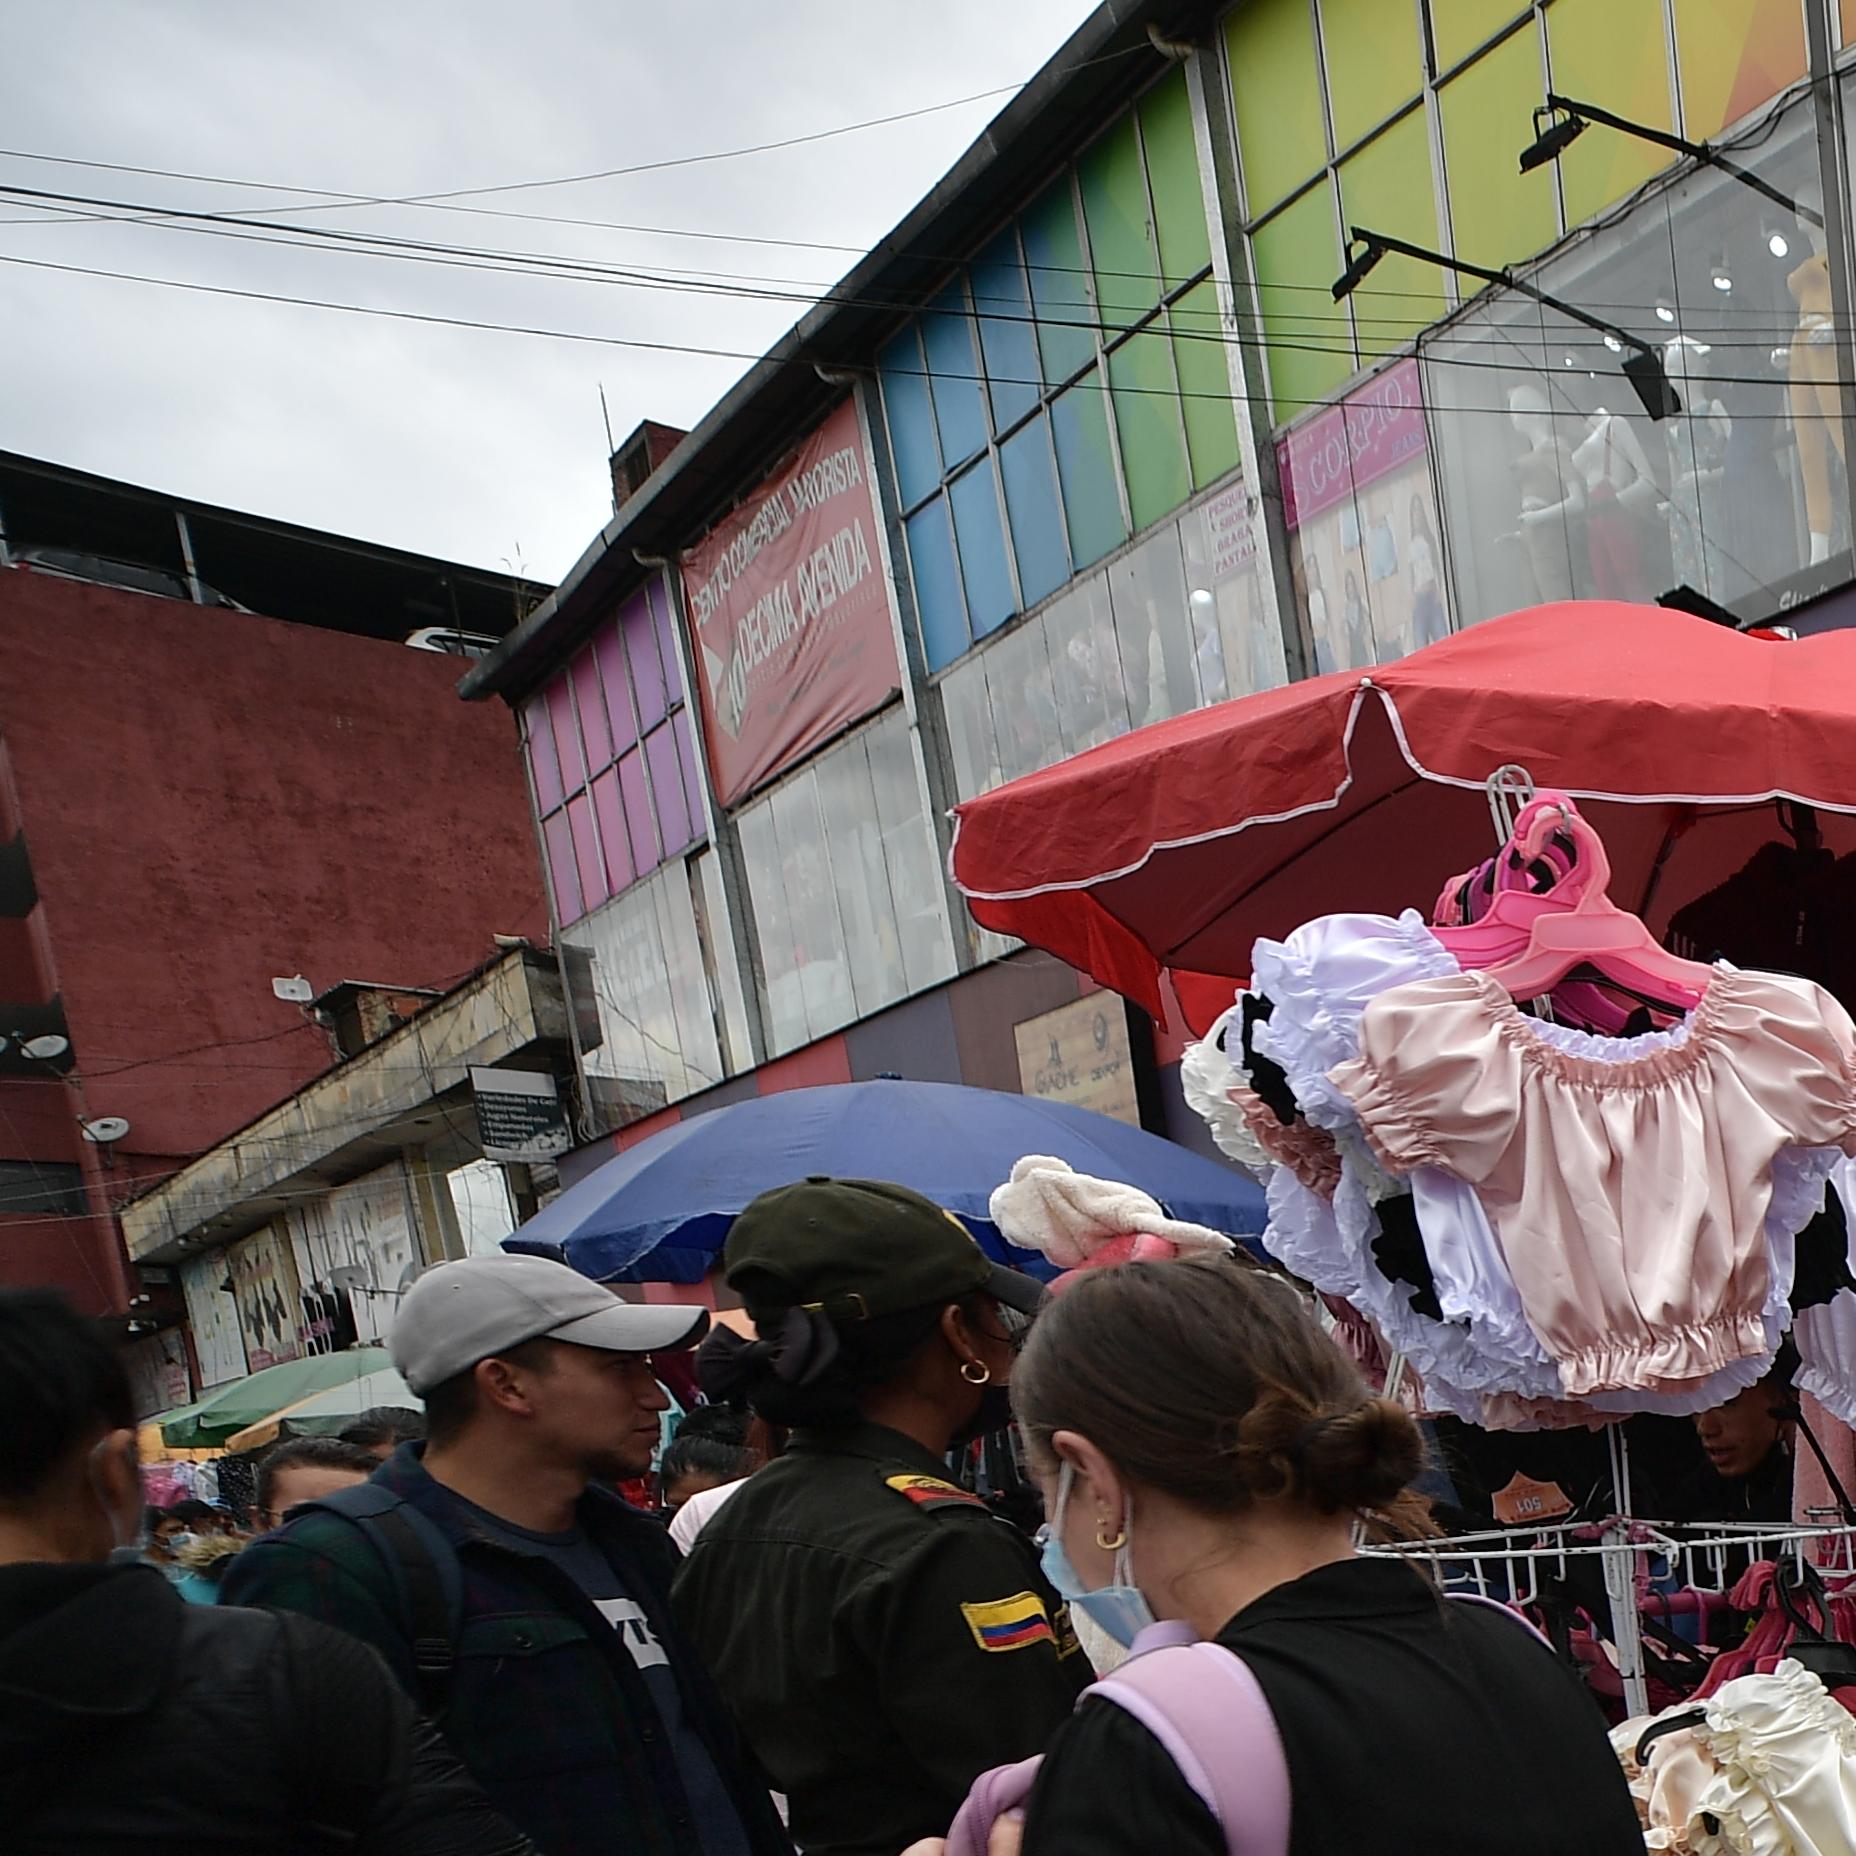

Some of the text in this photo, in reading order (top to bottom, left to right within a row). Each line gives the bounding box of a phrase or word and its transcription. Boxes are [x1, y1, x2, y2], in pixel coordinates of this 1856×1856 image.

[787, 445, 863, 516] MAYORISTA
[796, 516, 872, 626] AVENIDA
[1515, 1496, 1542, 1514] 501
